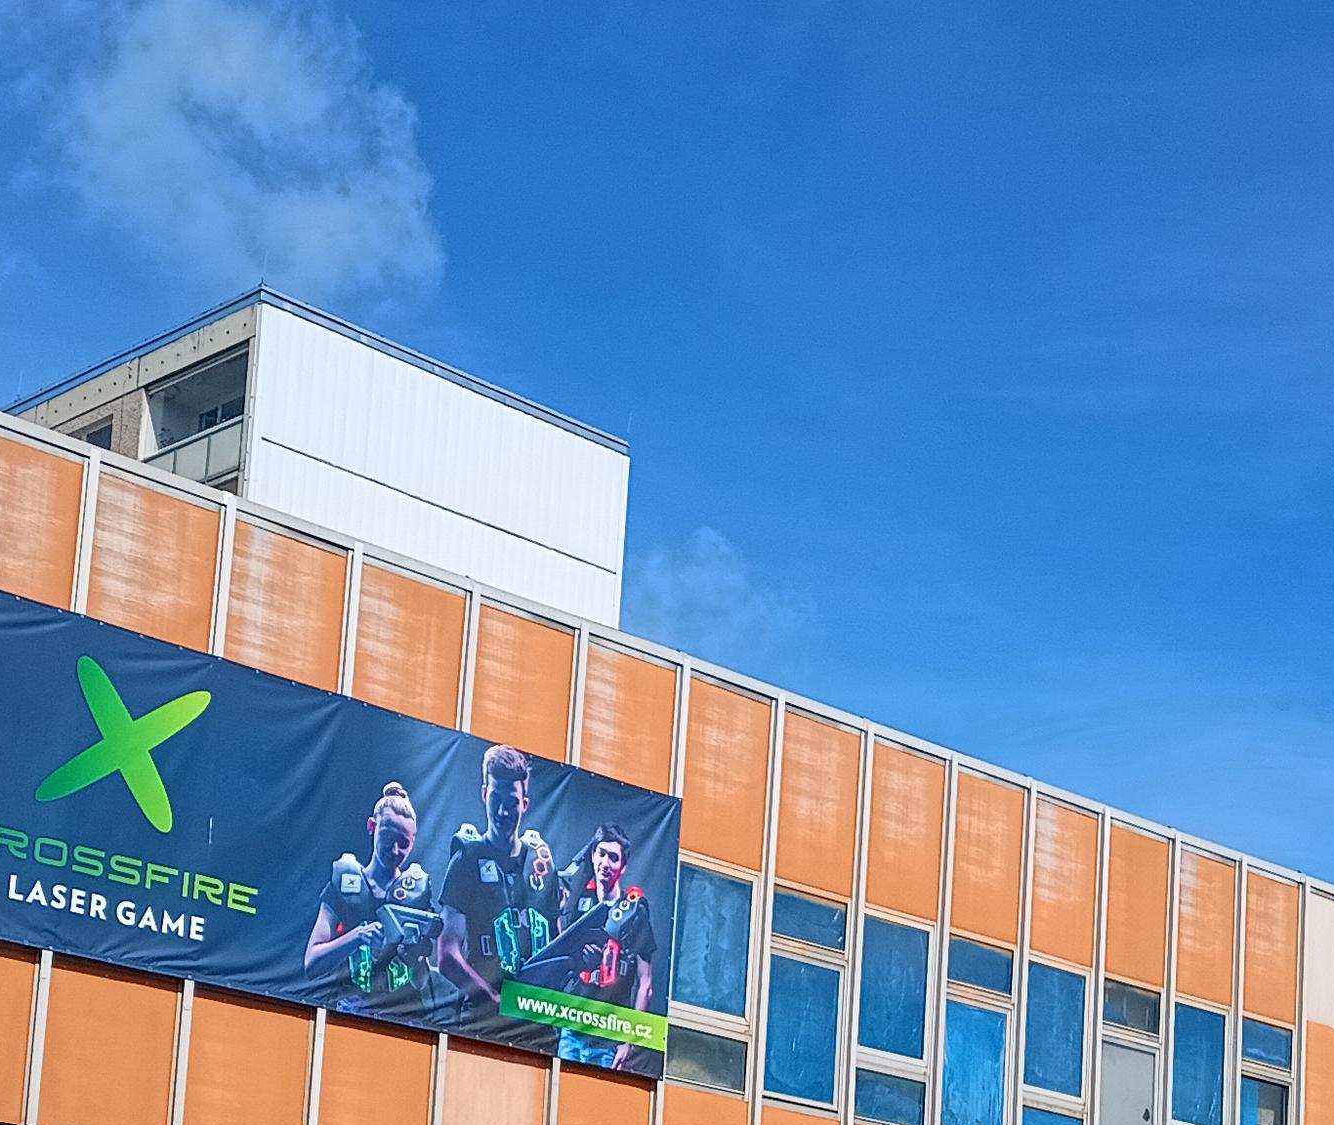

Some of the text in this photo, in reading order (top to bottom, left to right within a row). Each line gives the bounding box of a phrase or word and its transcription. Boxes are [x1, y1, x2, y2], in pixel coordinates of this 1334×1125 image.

[7, 874, 205, 941] LASER GAME
[517, 995, 653, 1039] www.xcrossfire.cz
